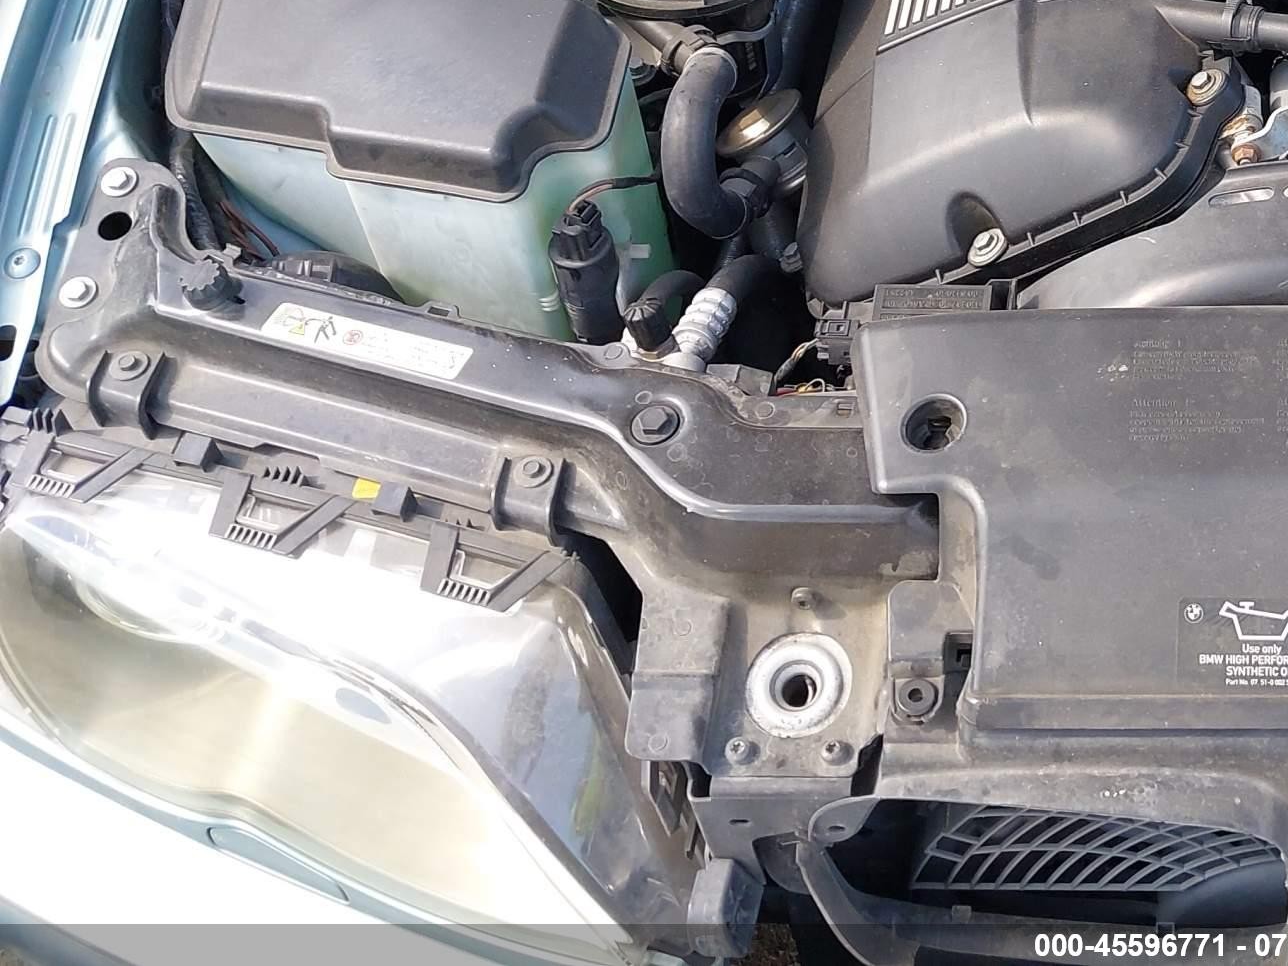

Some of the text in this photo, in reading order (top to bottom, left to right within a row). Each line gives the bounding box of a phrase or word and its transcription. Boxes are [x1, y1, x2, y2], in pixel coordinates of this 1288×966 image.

[1241, 643, 1282, 655] Use only
[1199, 654, 1224, 665] BMW
[1225, 654, 1250, 665] HIGH
[1225, 666, 1279, 677] SYNTHETIC
